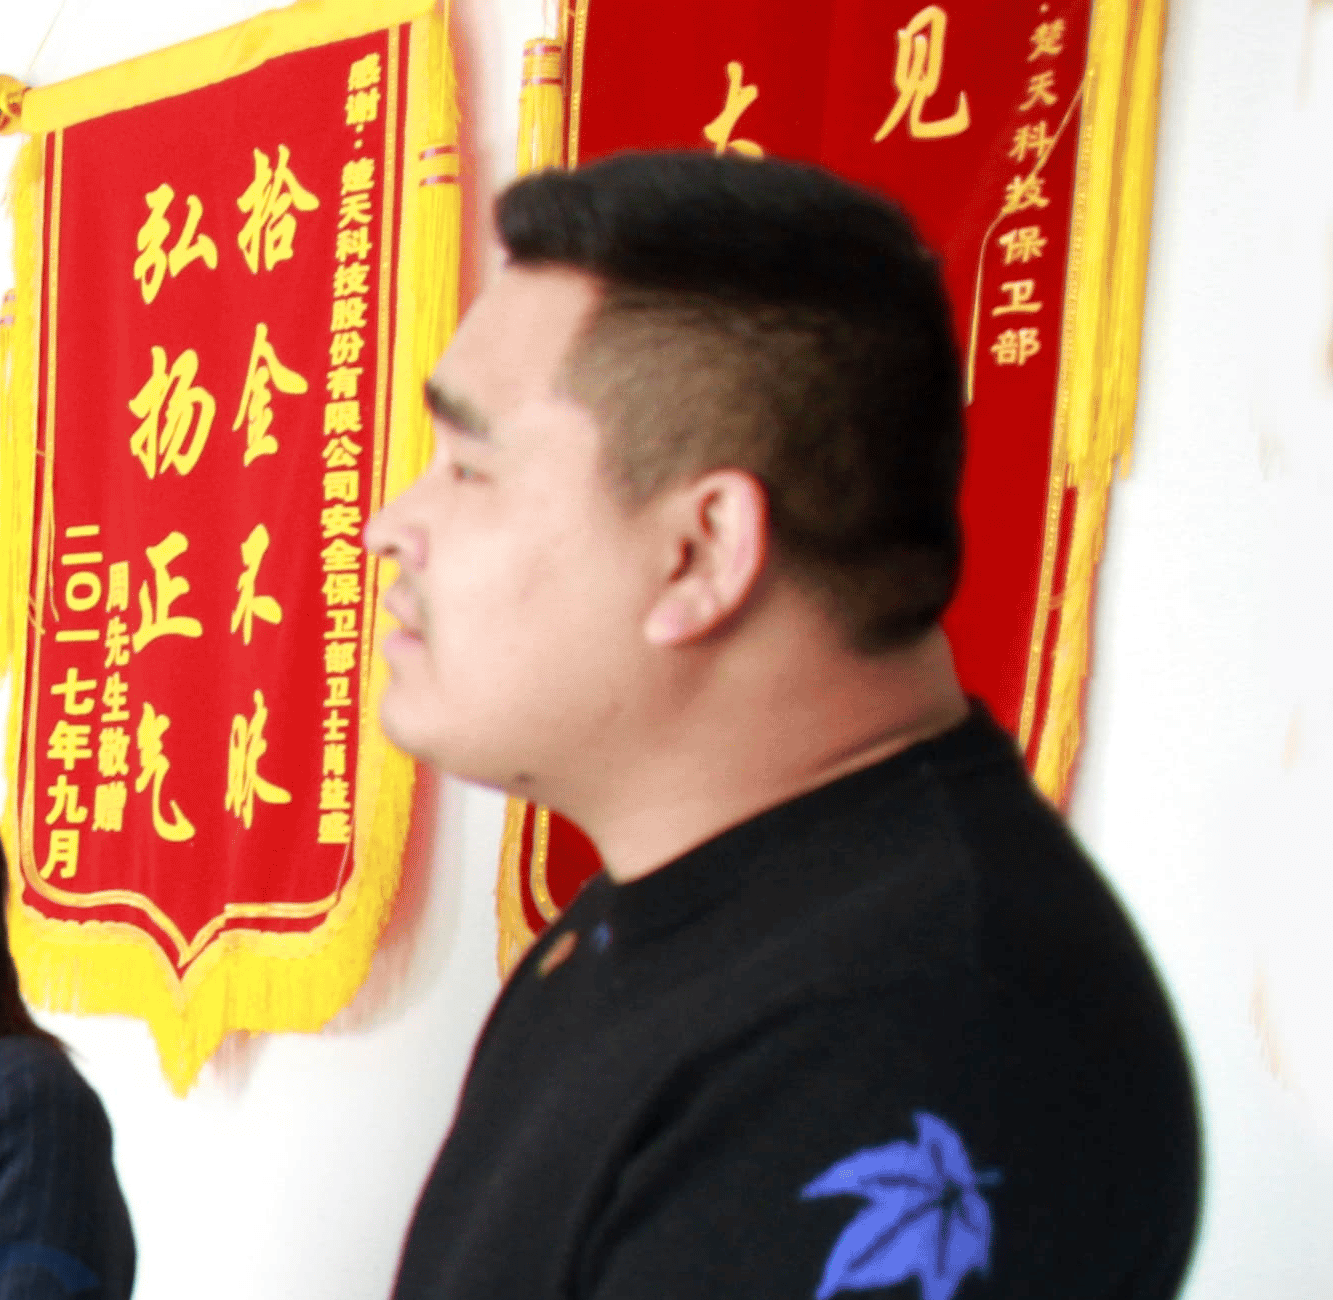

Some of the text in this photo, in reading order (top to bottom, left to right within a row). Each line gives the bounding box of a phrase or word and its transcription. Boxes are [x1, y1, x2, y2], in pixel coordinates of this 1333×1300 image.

[875, 5, 970, 142] 见
[224, 144, 320, 829] 拾金不昧
